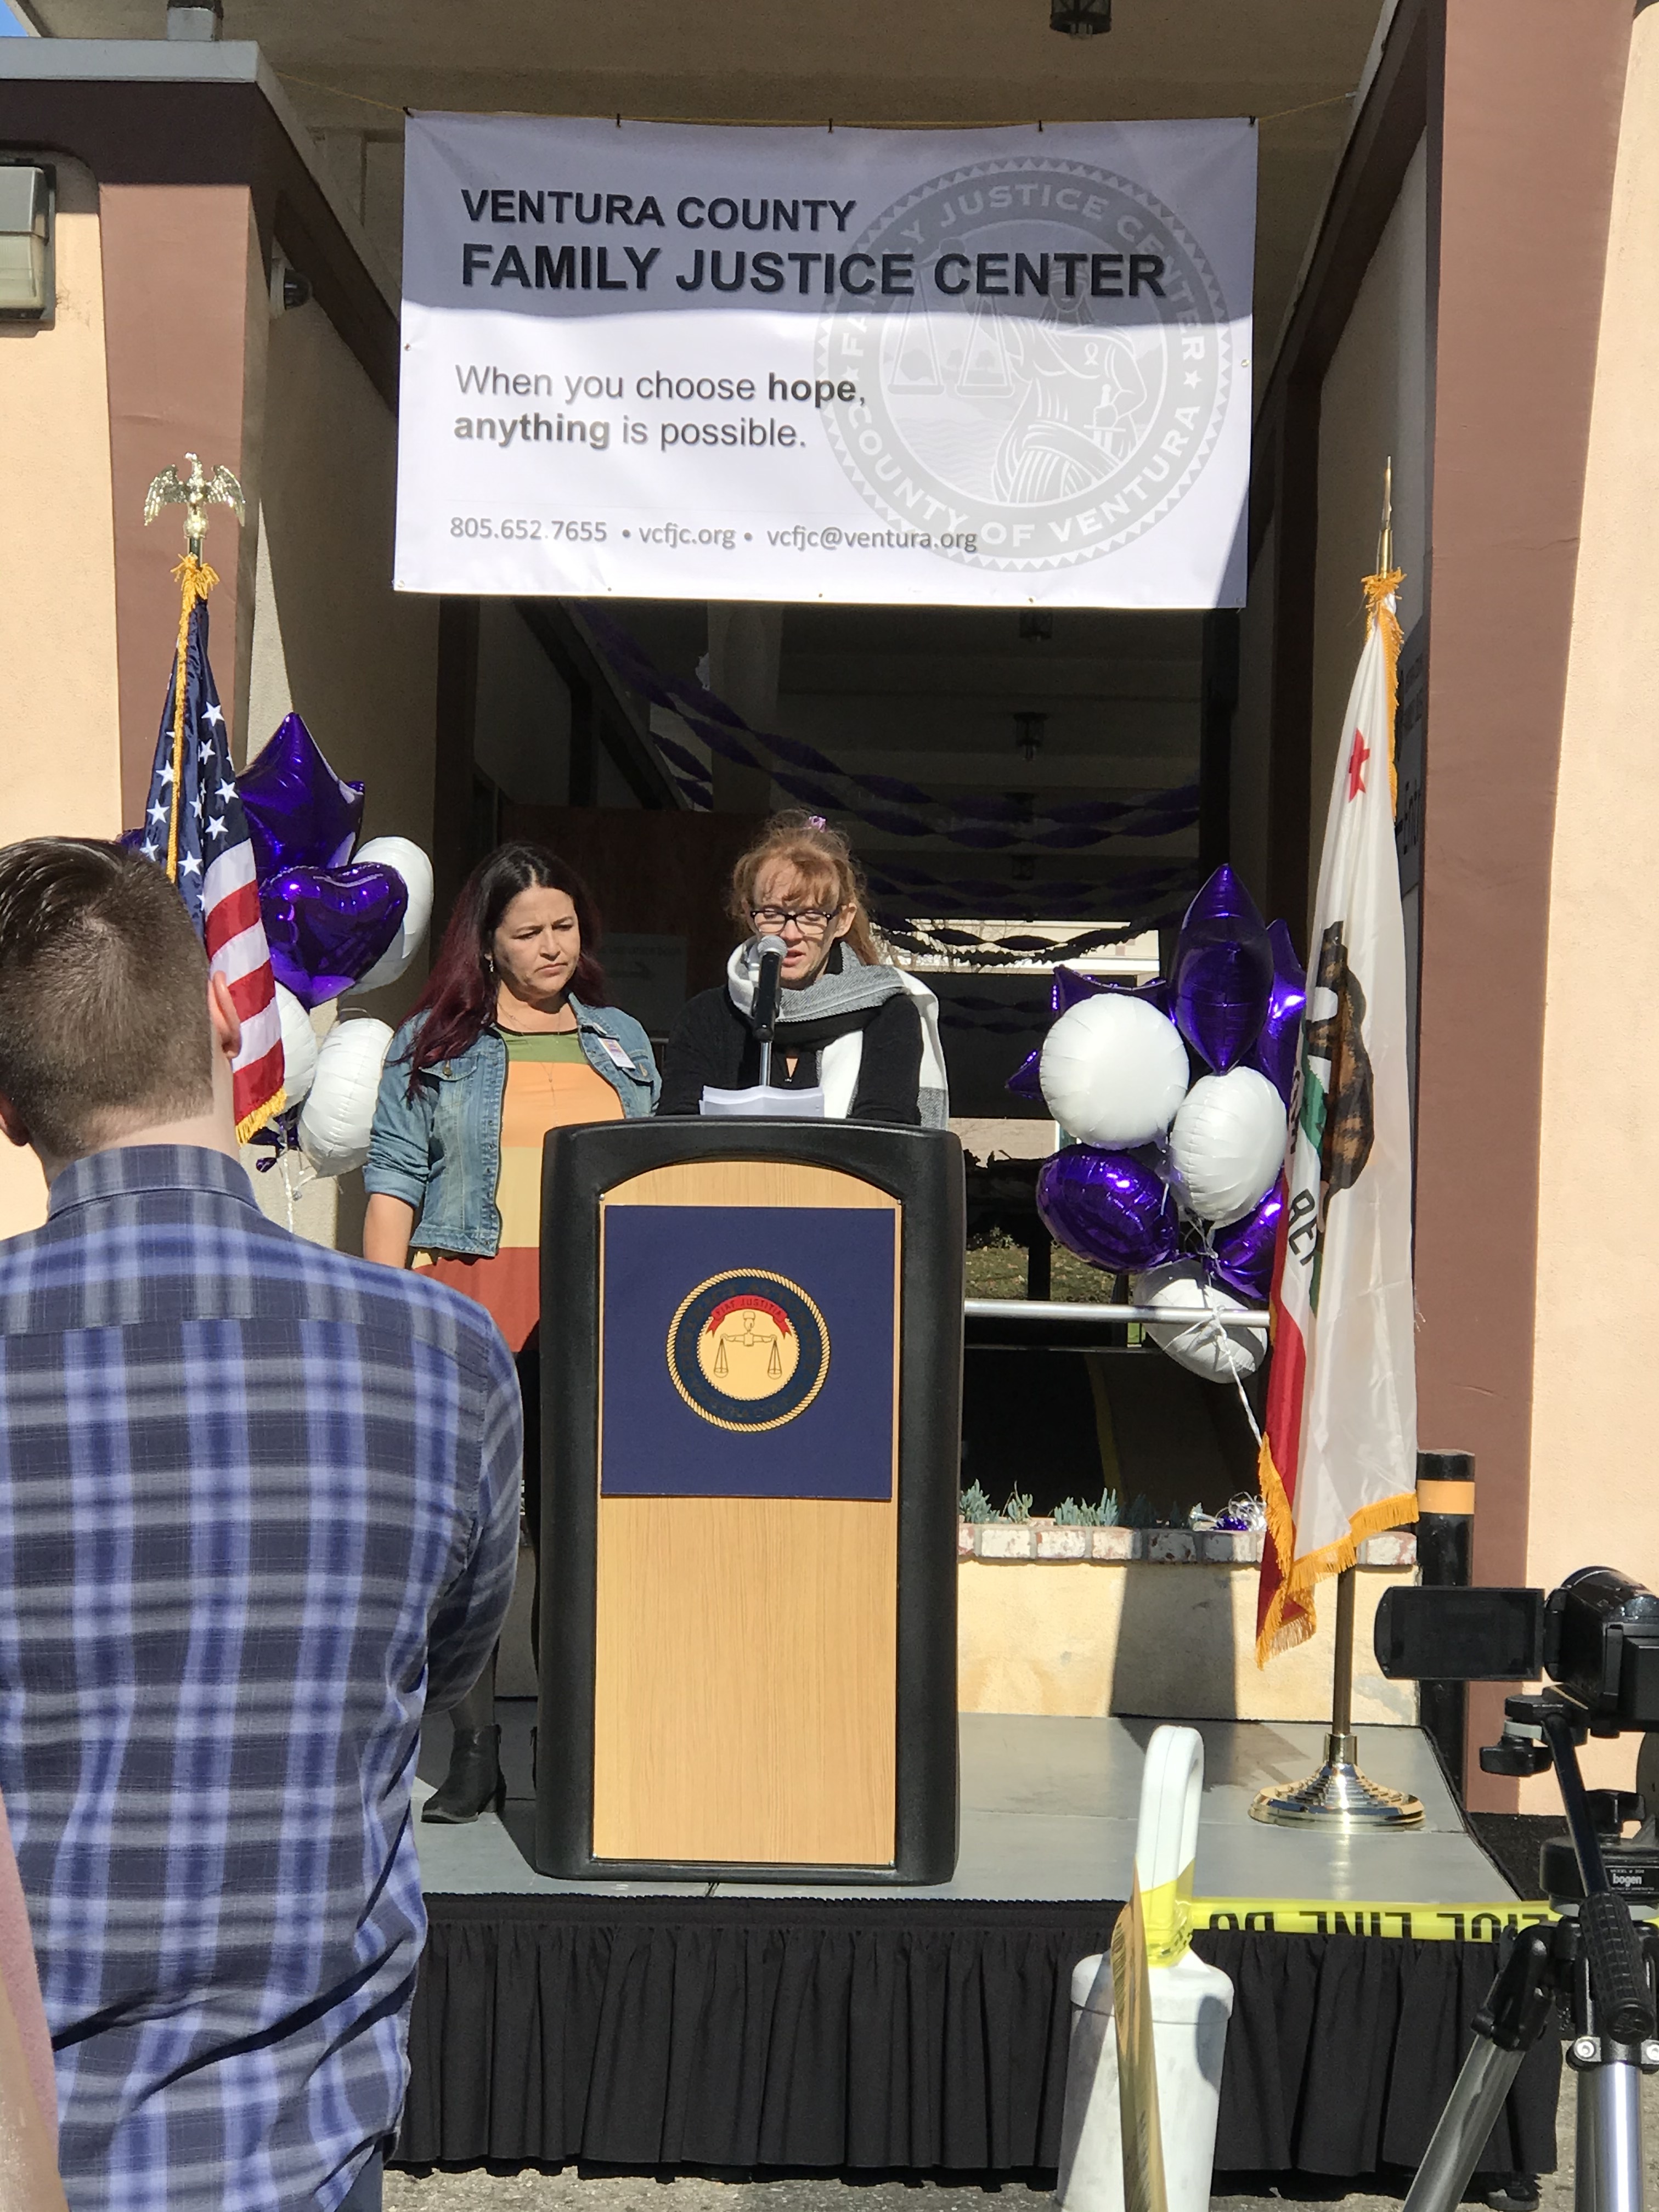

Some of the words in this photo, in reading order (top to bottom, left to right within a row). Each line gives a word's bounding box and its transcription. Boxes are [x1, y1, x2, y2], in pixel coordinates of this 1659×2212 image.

[461, 189, 665, 227] VENTURA
[677, 196, 856, 232] COUNTY
[940, 183, 1109, 227] JUSTICE
[462, 243, 661, 290] FAMILY
[676, 249, 915, 294] JUSTICE
[934, 253, 1166, 296] CENTER
[455, 364, 552, 396] When
[565, 375, 623, 405] you
[636, 370, 755, 400] choose
[769, 372, 865, 408] hope,
[454, 412, 610, 450] anything
[623, 415, 648, 444] is
[661, 417, 806, 452] possible.
[848, 402, 969, 533] COUNTY
[980, 521, 1035, 548] OF
[1048, 405, 1201, 543] VENTURA
[450, 516, 607, 542] 805.652.7655
[638, 522, 736, 549] vcfjc.org
[767, 524, 978, 553] vcfjc@ventura.org
[1613, 1874, 1642, 1887] bogen
